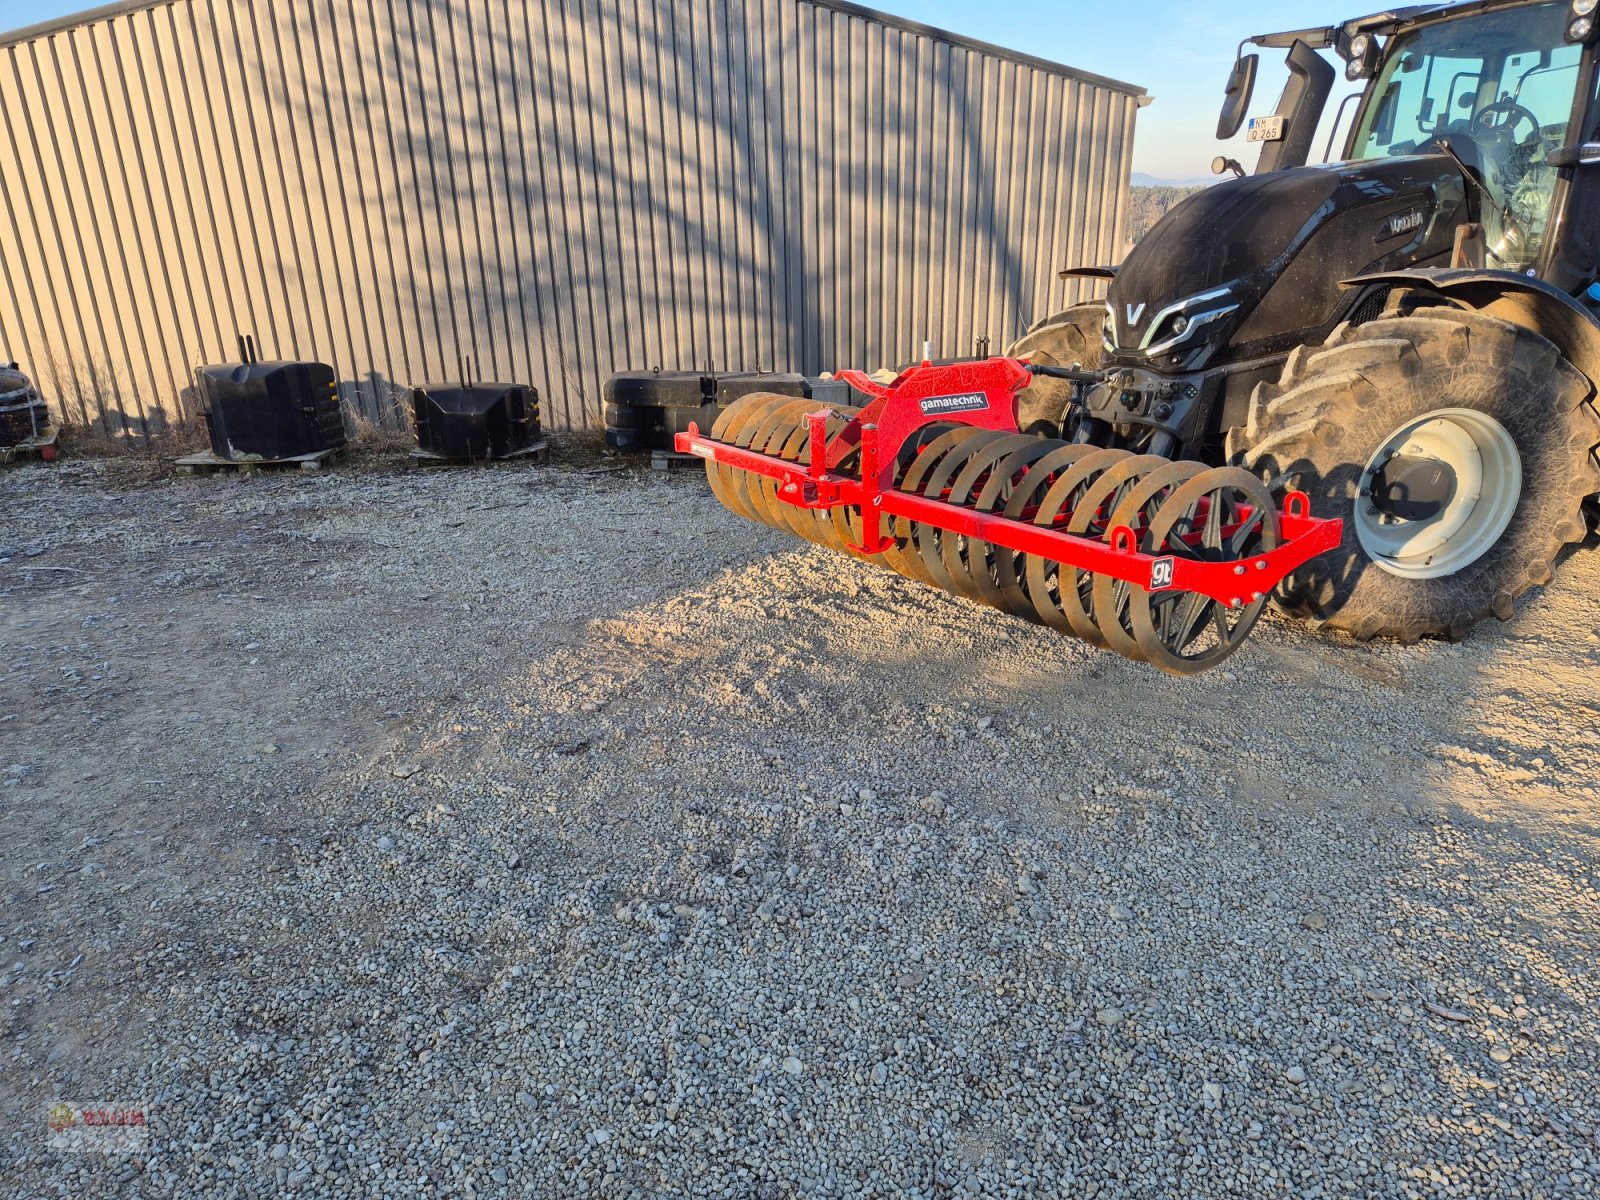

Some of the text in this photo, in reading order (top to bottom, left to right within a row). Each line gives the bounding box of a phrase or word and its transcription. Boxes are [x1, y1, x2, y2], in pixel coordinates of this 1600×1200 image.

[1255, 119, 1267, 129] NM
[1260, 128, 1277, 139] 265
[920, 395, 984, 412] gamatechnik
[1153, 562, 1171, 585] gt
